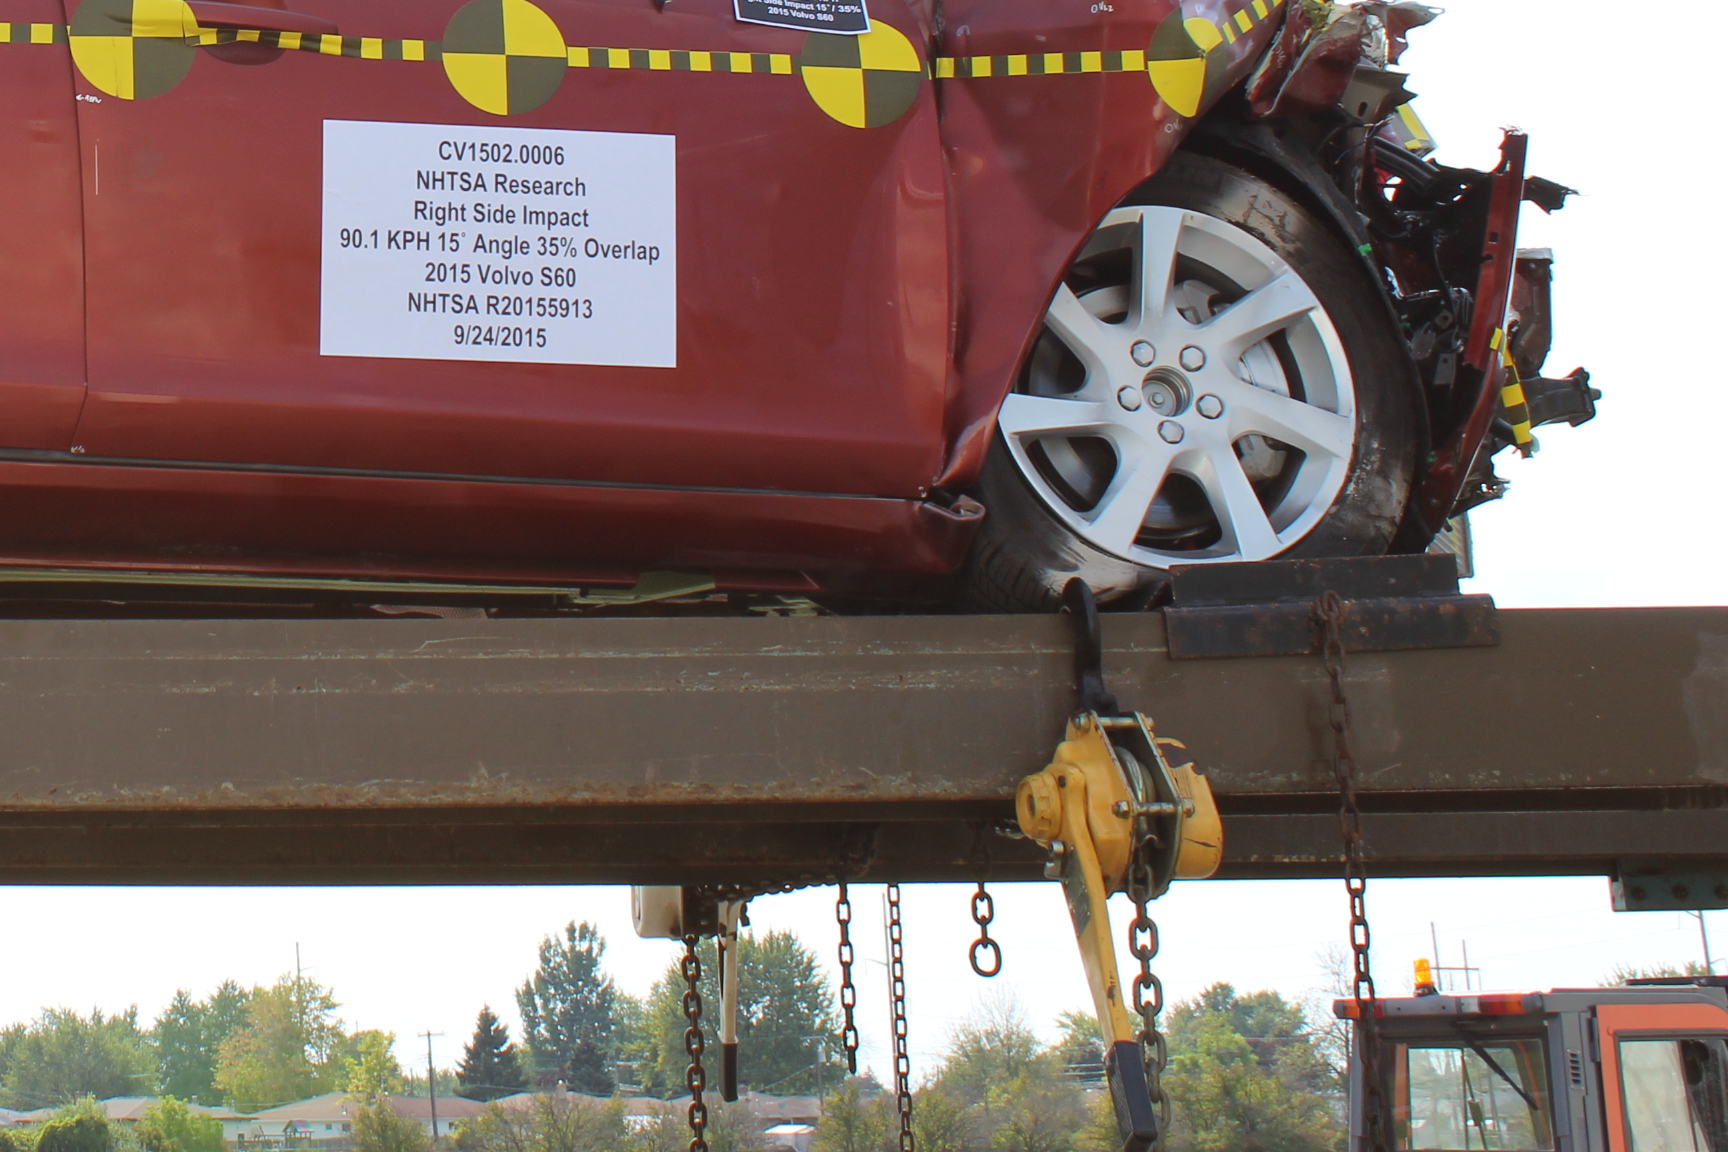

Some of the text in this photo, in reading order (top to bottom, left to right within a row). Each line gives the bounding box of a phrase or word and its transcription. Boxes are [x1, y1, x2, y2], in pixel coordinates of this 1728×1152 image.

[767, 6, 834, 22] 2015 Volvo S60
[784, 0, 815, 12] Impact
[837, 5, 862, 14] 35%
[438, 140, 565, 167] CV1502.0006
[416, 169, 587, 197] NHTSA Research
[414, 200, 590, 231] Right Side Impact
[340, 227, 661, 266] 90.1 KPH 15° Angle 35% Overlap
[424, 261, 578, 289] 2015 Volvo S60
[408, 291, 594, 319] NHTSA R20155913
[453, 324, 548, 348] 9/24/2015
